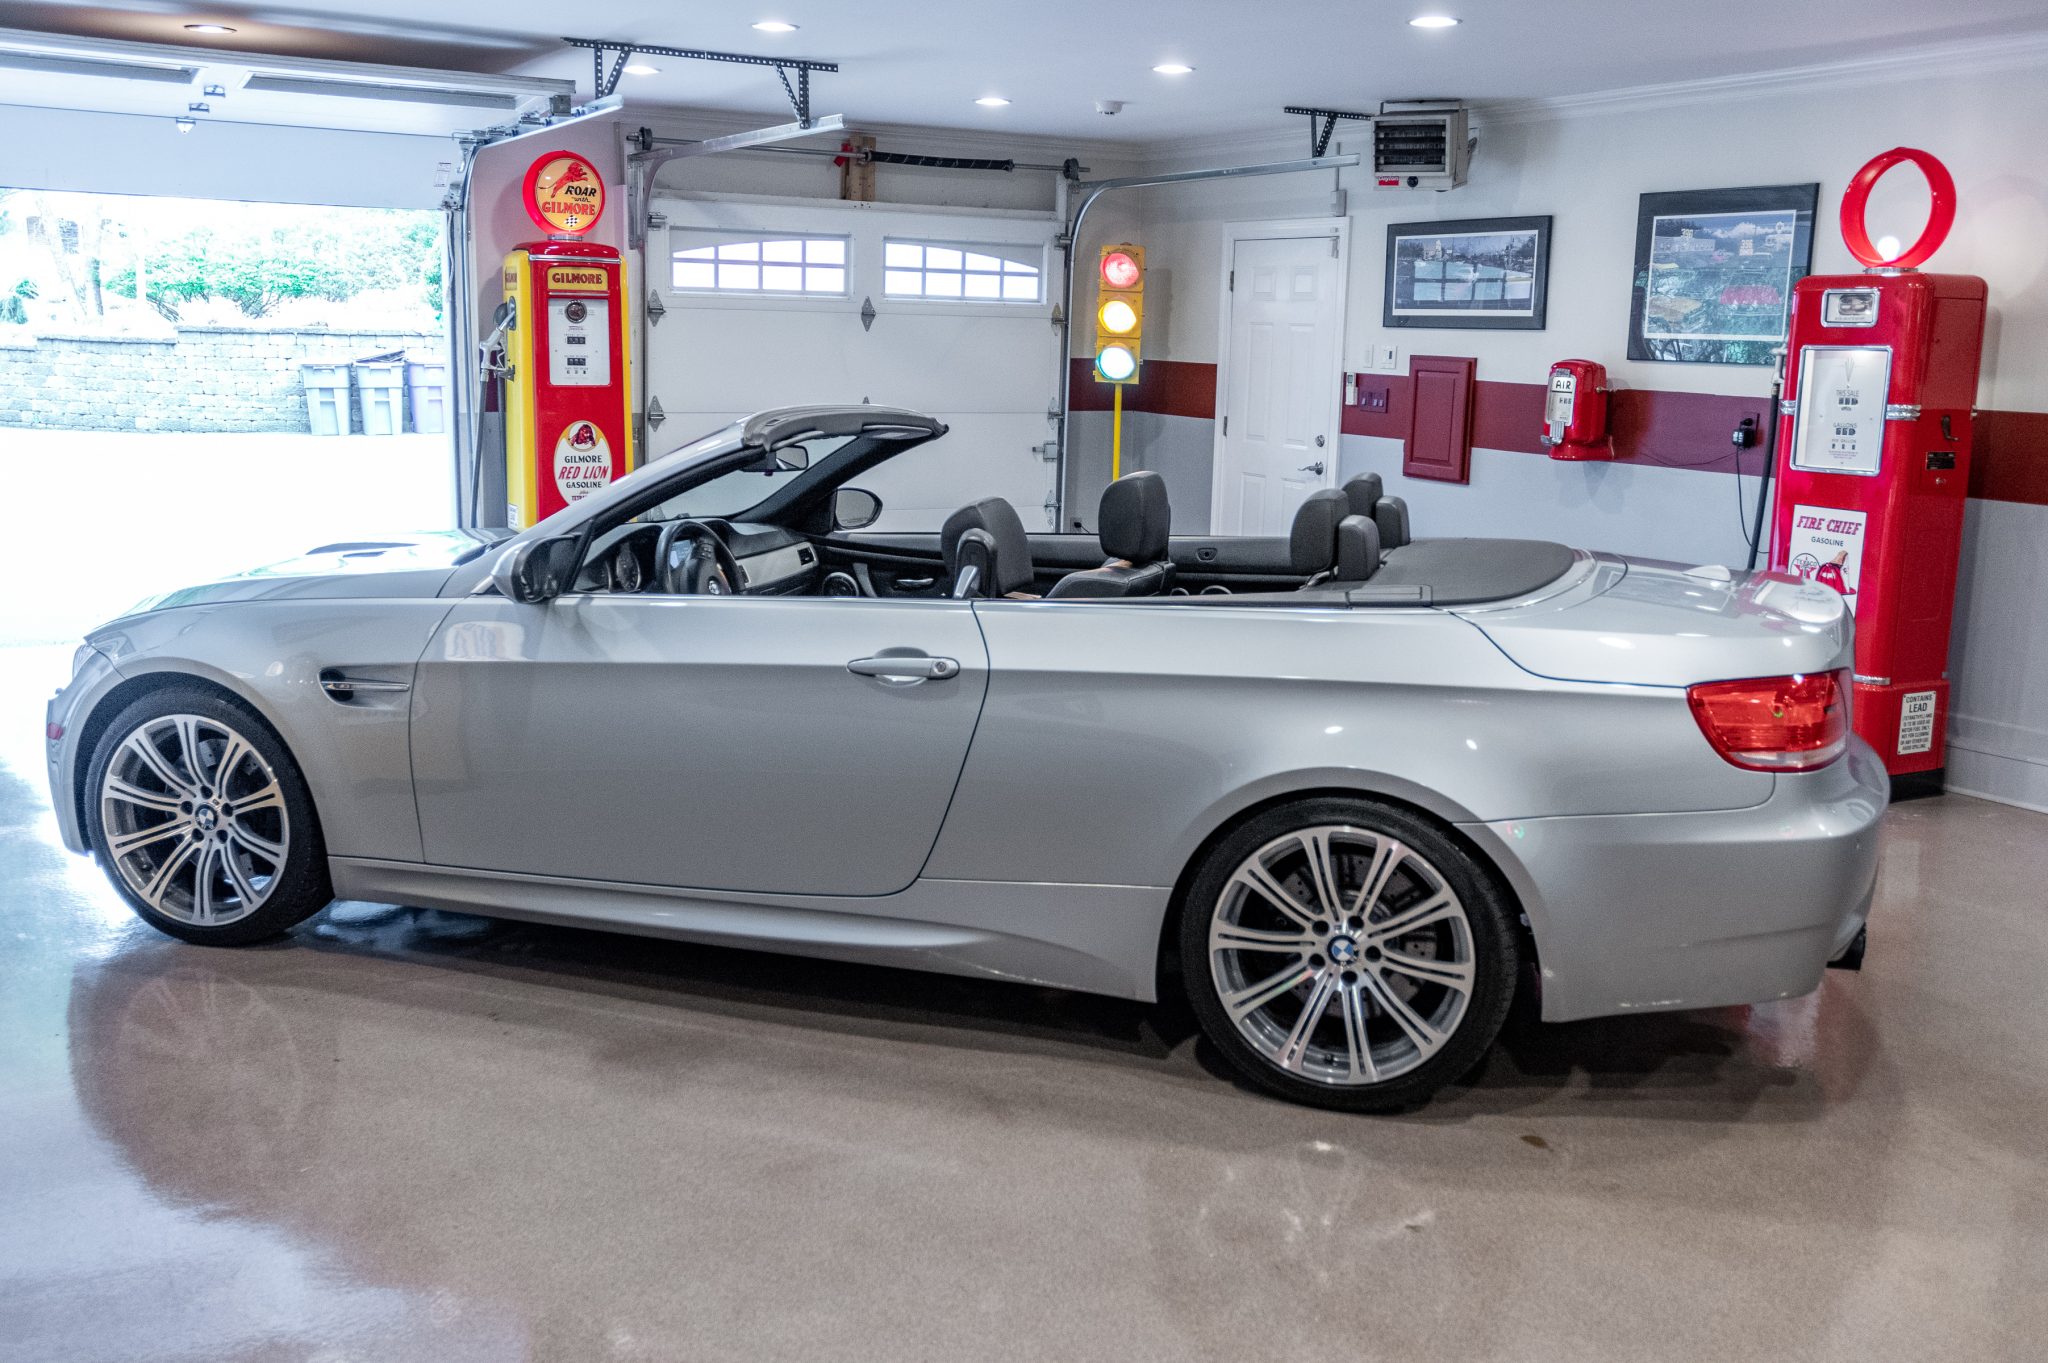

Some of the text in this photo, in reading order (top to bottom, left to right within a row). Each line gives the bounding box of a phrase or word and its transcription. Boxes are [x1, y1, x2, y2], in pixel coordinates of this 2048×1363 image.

[565, 185, 597, 197] ROAR
[541, 201, 596, 216] GILMORE
[552, 272, 603, 285] GILMORE
[1555, 380, 1572, 390] AIR
[564, 455, 603, 464] GILMORE
[559, 465, 610, 480] RED LION
[566, 481, 602, 489] GASOLINE
[1797, 516, 1862, 535] FIRE CHIEF
[1811, 536, 1844, 547] GASOLINE
[1796, 558, 1818, 567] TEXACO
[1905, 695, 1932, 703] CONTAINS
[1909, 703, 1928, 713] LEAD
